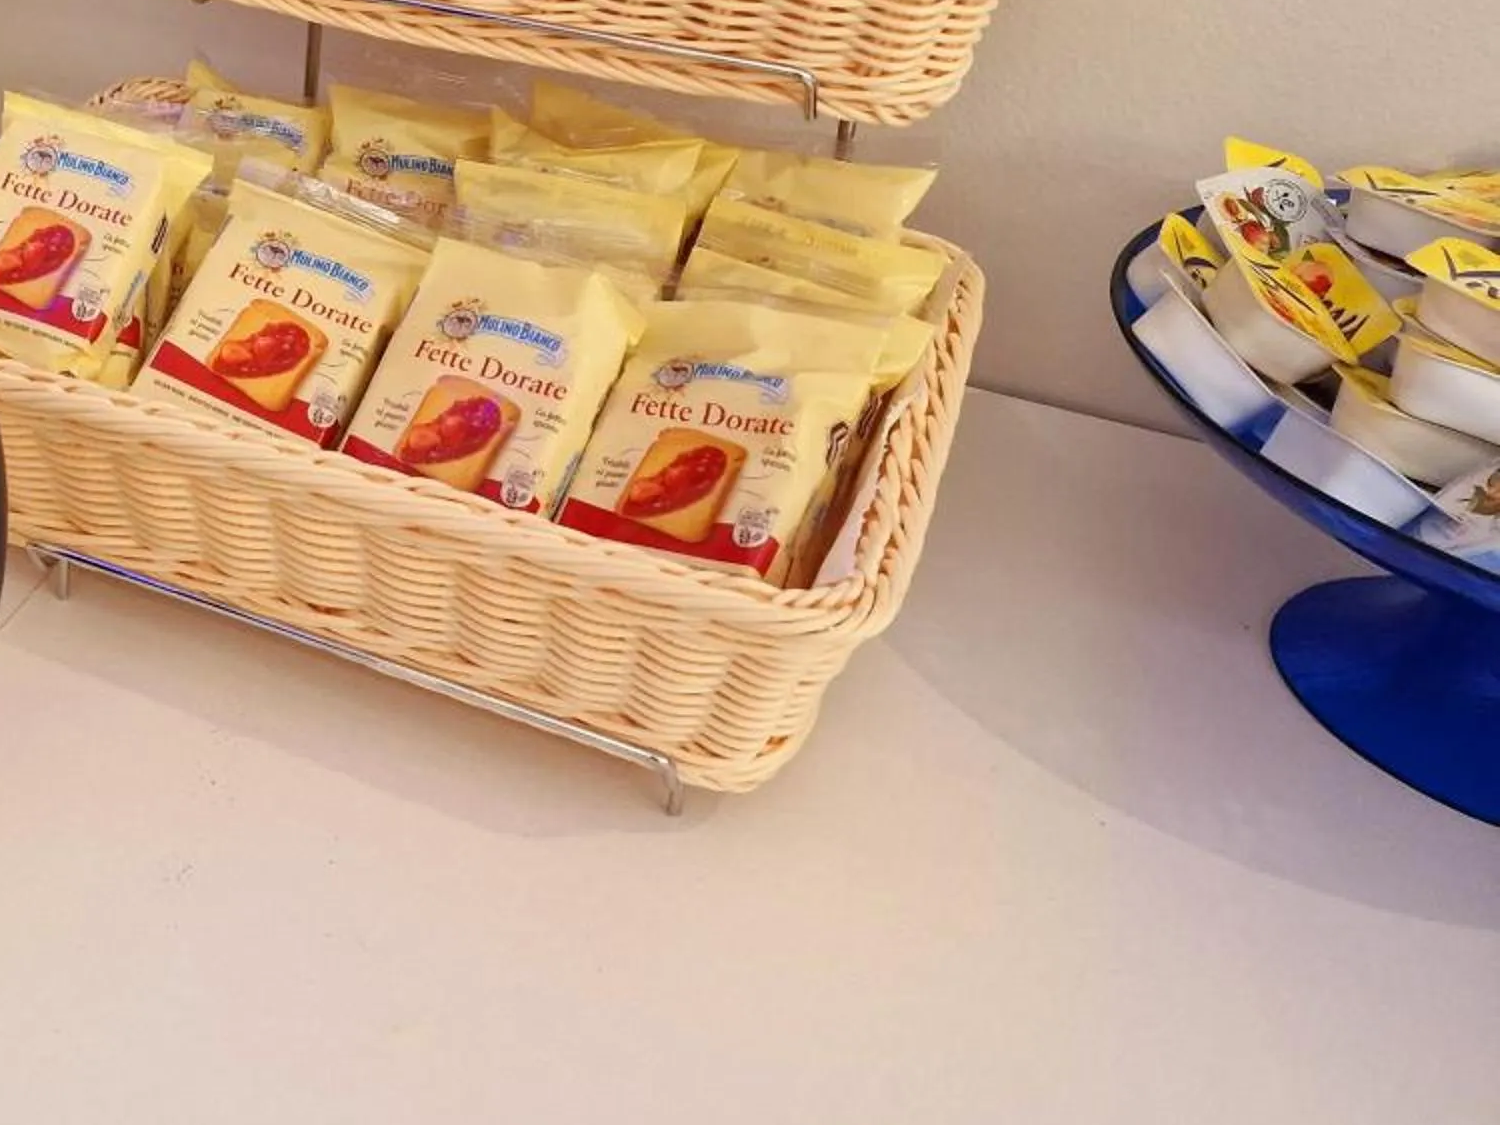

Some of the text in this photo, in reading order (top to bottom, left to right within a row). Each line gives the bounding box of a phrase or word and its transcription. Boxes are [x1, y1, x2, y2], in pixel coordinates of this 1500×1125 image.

[1, 172, 133, 227] Fette Dorate
[228, 262, 373, 334] Fette Dorate
[414, 339, 473, 372] Fette
[479, 355, 568, 401] Dorate
[630, 392, 795, 436] Fette Dorate
